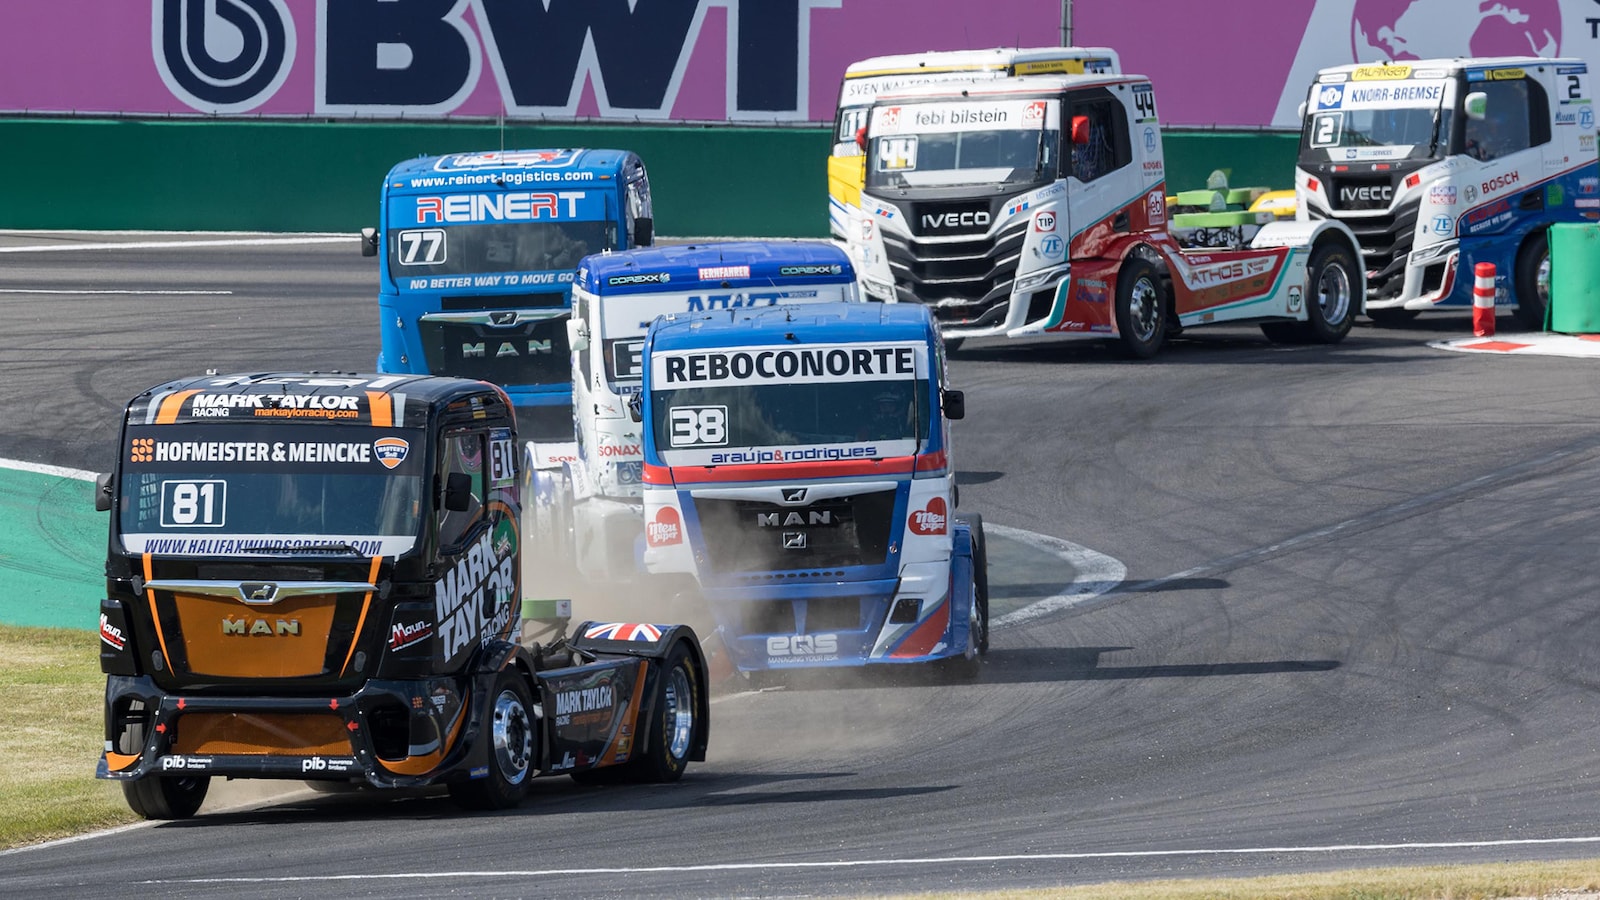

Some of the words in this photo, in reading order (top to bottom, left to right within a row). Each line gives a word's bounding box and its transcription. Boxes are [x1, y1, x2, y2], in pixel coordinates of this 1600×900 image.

[1351, 86, 1441, 103] KNORR-BREMSE
[1567, 75, 1581, 99] 2
[1135, 91, 1155, 118] 44
[915, 109, 945, 126] febi
[950, 107, 1008, 124] bilstein
[1317, 116, 1334, 143] 2
[881, 139, 916, 169] 44
[410, 170, 594, 188] www.reinert-logistics.com
[1481, 170, 1520, 195] BOSCH
[416, 191, 586, 224] REINERT
[921, 211, 991, 229] IVECO
[1037, 217, 1054, 227] TIP
[1434, 217, 1452, 232] ZF
[402, 232, 443, 263] 77
[609, 274, 660, 285] COREXX
[699, 265, 750, 279] FERNFAHRER
[781, 265, 830, 275] COREXX
[1191, 263, 1243, 285] ATHOS
[410, 279, 428, 290] NO
[430, 277, 471, 289] BETTER
[474, 276, 501, 287] WAY
[504, 274, 519, 285] TO
[521, 273, 554, 284] MOVE
[462, 339, 552, 358] MAN
[665, 347, 914, 383] REBOCONORTE
[192, 394, 266, 408] MARK
[266, 394, 360, 410] TAYLOR
[192, 407, 230, 418] RACING
[254, 407, 359, 419] marktaylorracing.com
[671, 408, 726, 445] 38
[155, 441, 269, 463] HOFMEISTER
[271, 442, 286, 462] &
[288, 442, 371, 463] MEINCKE
[492, 441, 512, 479] 81
[598, 444, 642, 457] SONAX
[172, 483, 215, 524] 81
[757, 510, 831, 527] MAN
[435, 524, 498, 623] MARK
[222, 618, 300, 636] MAN
[556, 690, 582, 715] MARK
[581, 685, 612, 711] TAYLOR
[162, 754, 186, 771] pib
[302, 756, 327, 772] pib
